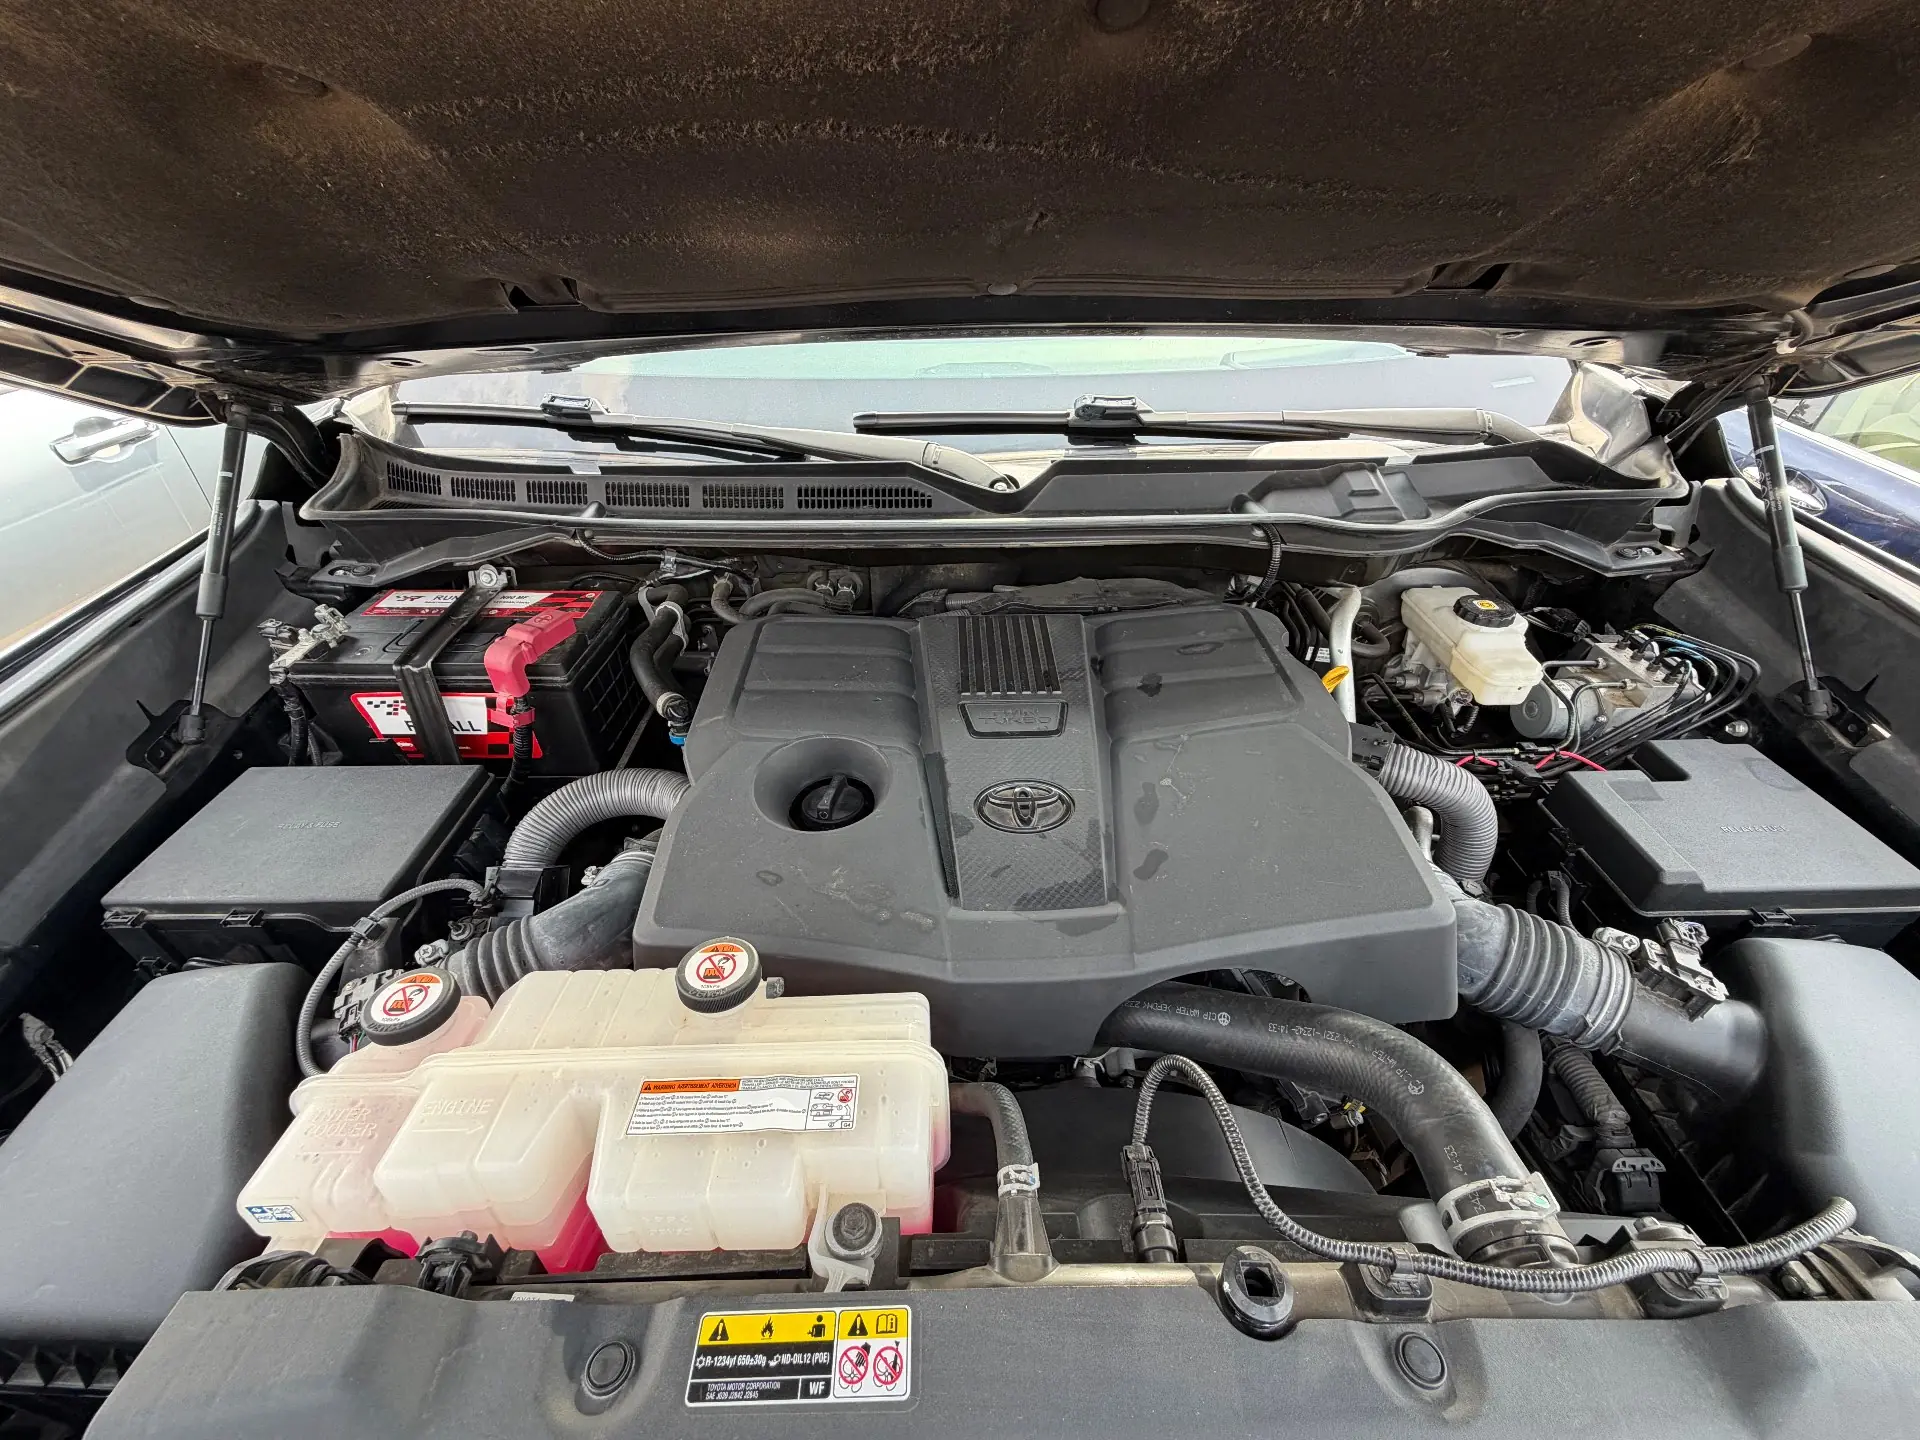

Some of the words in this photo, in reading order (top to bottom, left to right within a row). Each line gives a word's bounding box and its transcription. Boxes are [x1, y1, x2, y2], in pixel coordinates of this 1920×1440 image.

[1175, 1006, 1200, 1018] WATER
[421, 1098, 495, 1116] ENGINE
[1443, 1144, 1468, 1176] 4:33
[705, 1354, 737, 1369] R-1234yf
[737, 1353, 767, 1368] 650±30g
[707, 1383, 726, 1392] TOYOTA
[727, 1382, 745, 1391] MOTOR
[746, 1381, 781, 1390] CORPORATION
[809, 1381, 826, 1395] WF
[705, 1391, 716, 1400] SAE
